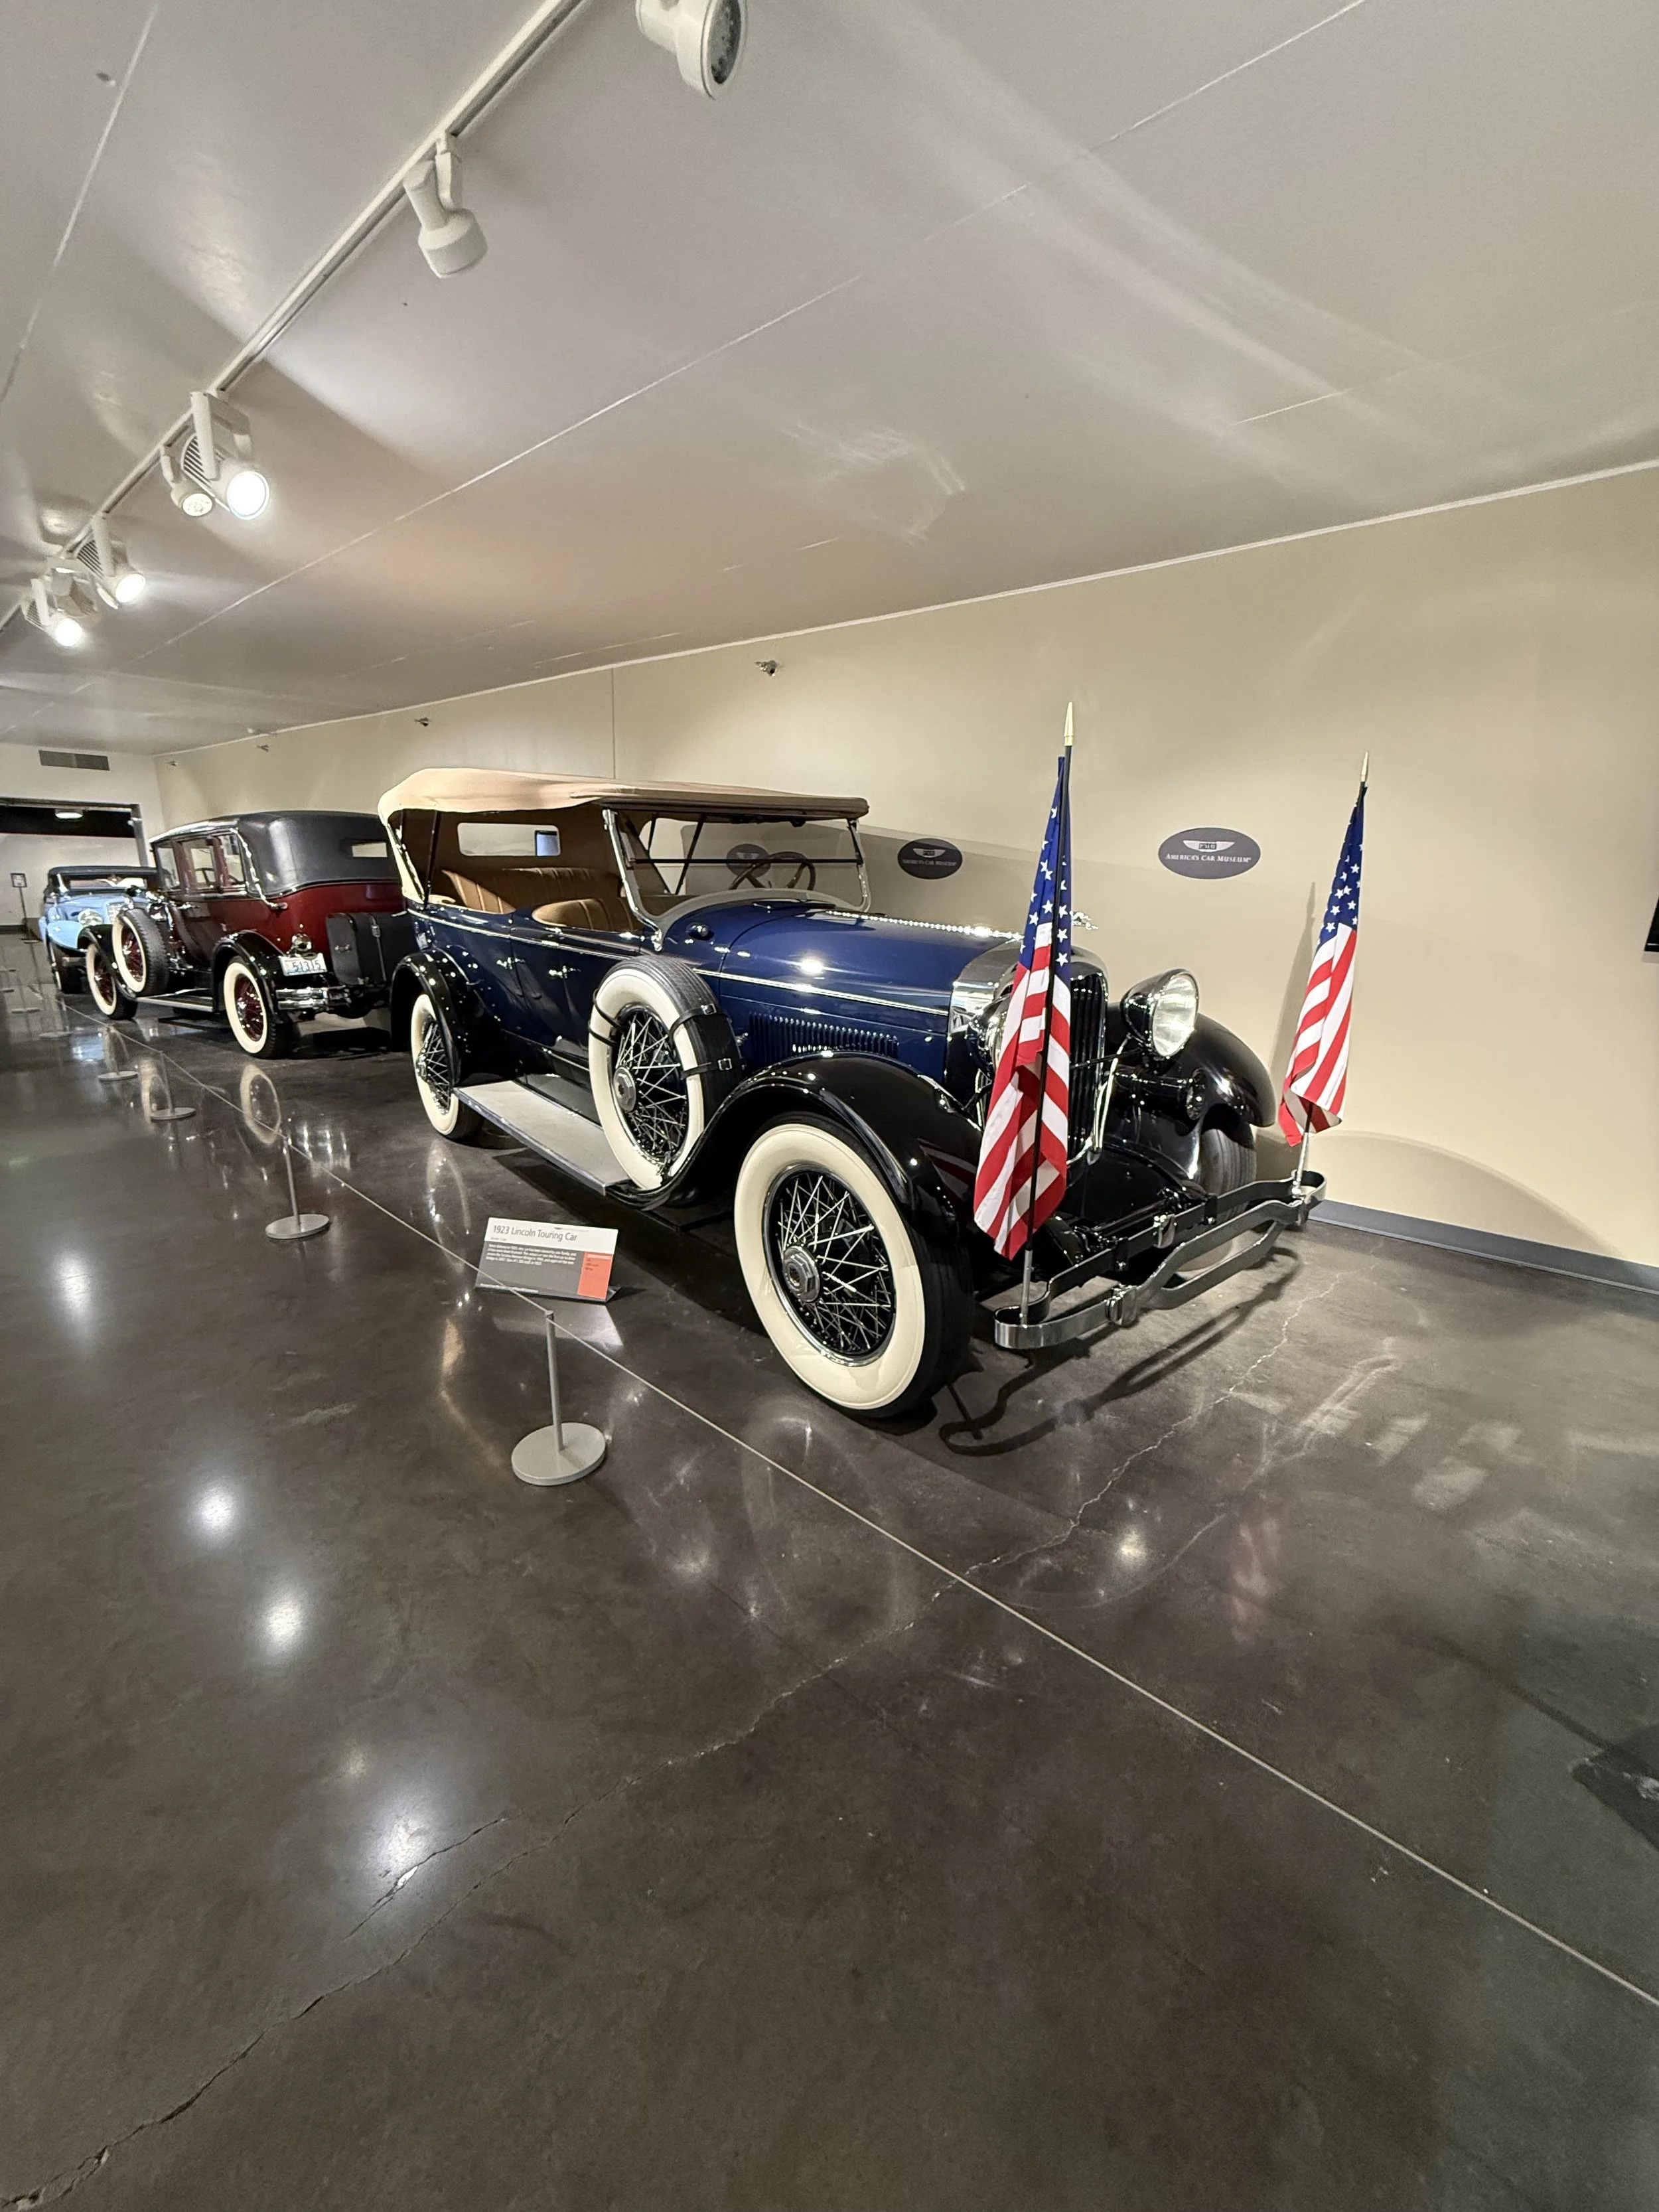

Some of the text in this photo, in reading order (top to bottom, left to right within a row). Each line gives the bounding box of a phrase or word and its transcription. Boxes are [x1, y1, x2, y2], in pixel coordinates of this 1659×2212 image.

[493, 1224, 510, 1234] 1923
[511, 1227, 536, 1238] Lincoln
[538, 1229, 563, 1242] Touring
[565, 1232, 578, 1241] Car
